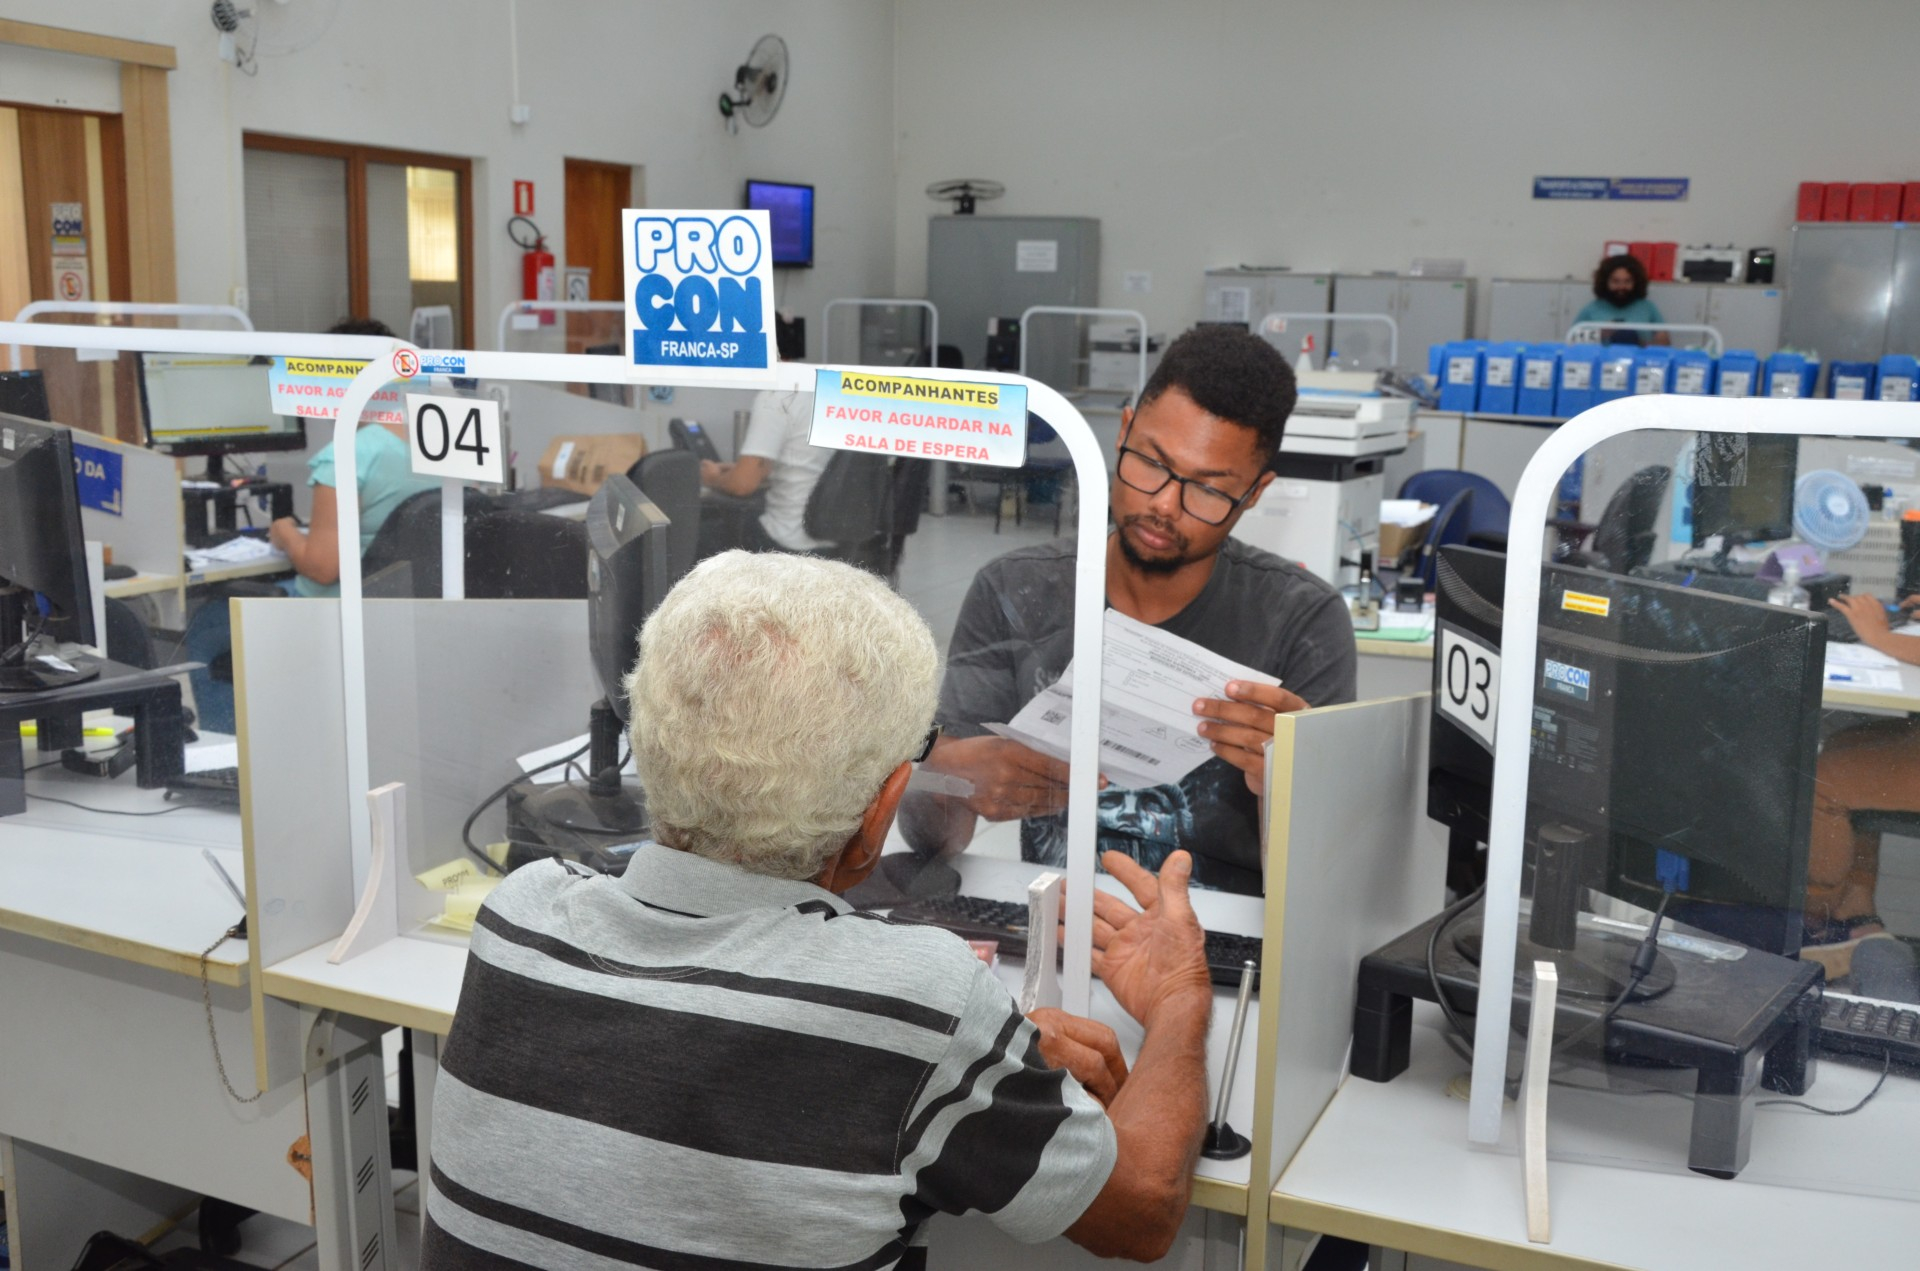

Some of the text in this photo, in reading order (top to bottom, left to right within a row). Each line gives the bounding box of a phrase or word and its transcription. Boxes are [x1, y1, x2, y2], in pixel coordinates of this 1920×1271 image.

[635, 215, 762, 276] PRO
[635, 273, 763, 332] CON
[661, 340, 739, 358] FRANCA-SP
[287, 362, 364, 375] ACOMPANH
[278, 384, 399, 402] FAVOR AGDAR
[841, 377, 998, 405] ACOMPANHANTES
[296, 405, 329, 417] SALA
[361, 410, 403, 423] SPERA
[825, 406, 1013, 436] FAVOR AGUARDAR NA
[416, 403, 490, 466] 04
[844, 434, 989, 460] SALA DE ESPERA
[1447, 644, 1491, 721] 03
[1545, 661, 1589, 687] PROCON
